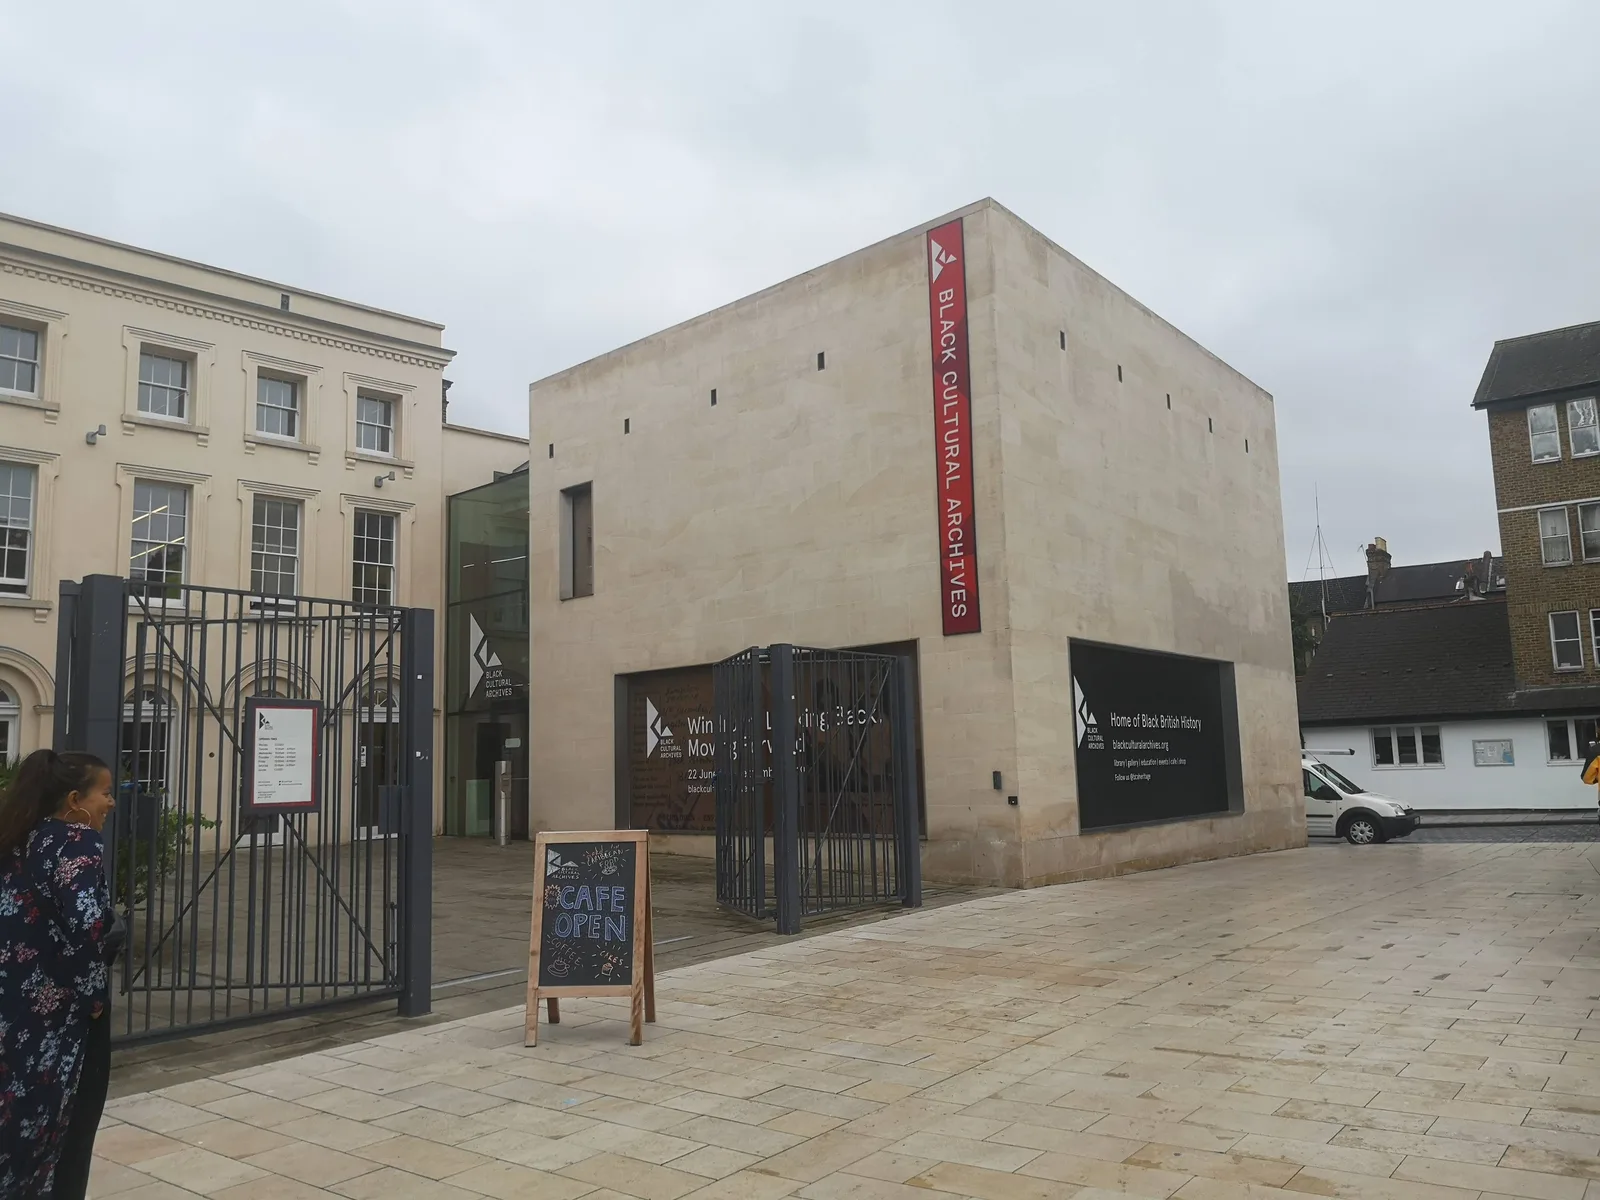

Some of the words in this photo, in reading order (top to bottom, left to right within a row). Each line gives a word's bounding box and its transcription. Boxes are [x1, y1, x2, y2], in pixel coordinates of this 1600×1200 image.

[939, 287, 957, 365] BLACK
[942, 371, 961, 490] CULTURAL
[946, 498, 967, 618] ARCHIVES
[486, 670, 502, 679] BLACK
[486, 678, 511, 688] CULTURAL
[485, 688, 512, 697] ARCHIVES
[1110, 712, 1131, 728] Home
[1132, 713, 1140, 727] of
[1141, 713, 1160, 728] Black
[1160, 714, 1180, 729] British
[1180, 716, 1202, 733] History
[1087, 742, 1105, 750] ARCHIVES
[1112, 740, 1169, 751] blackculturalarchives.org
[660, 751, 682, 759] ARCHIVES
[687, 769, 697, 780] 22
[560, 885, 625, 912] CAFE
[555, 912, 626, 942] OPEN
[551, 938, 582, 966] COFFEE
[600, 950, 624, 966] CAKES
